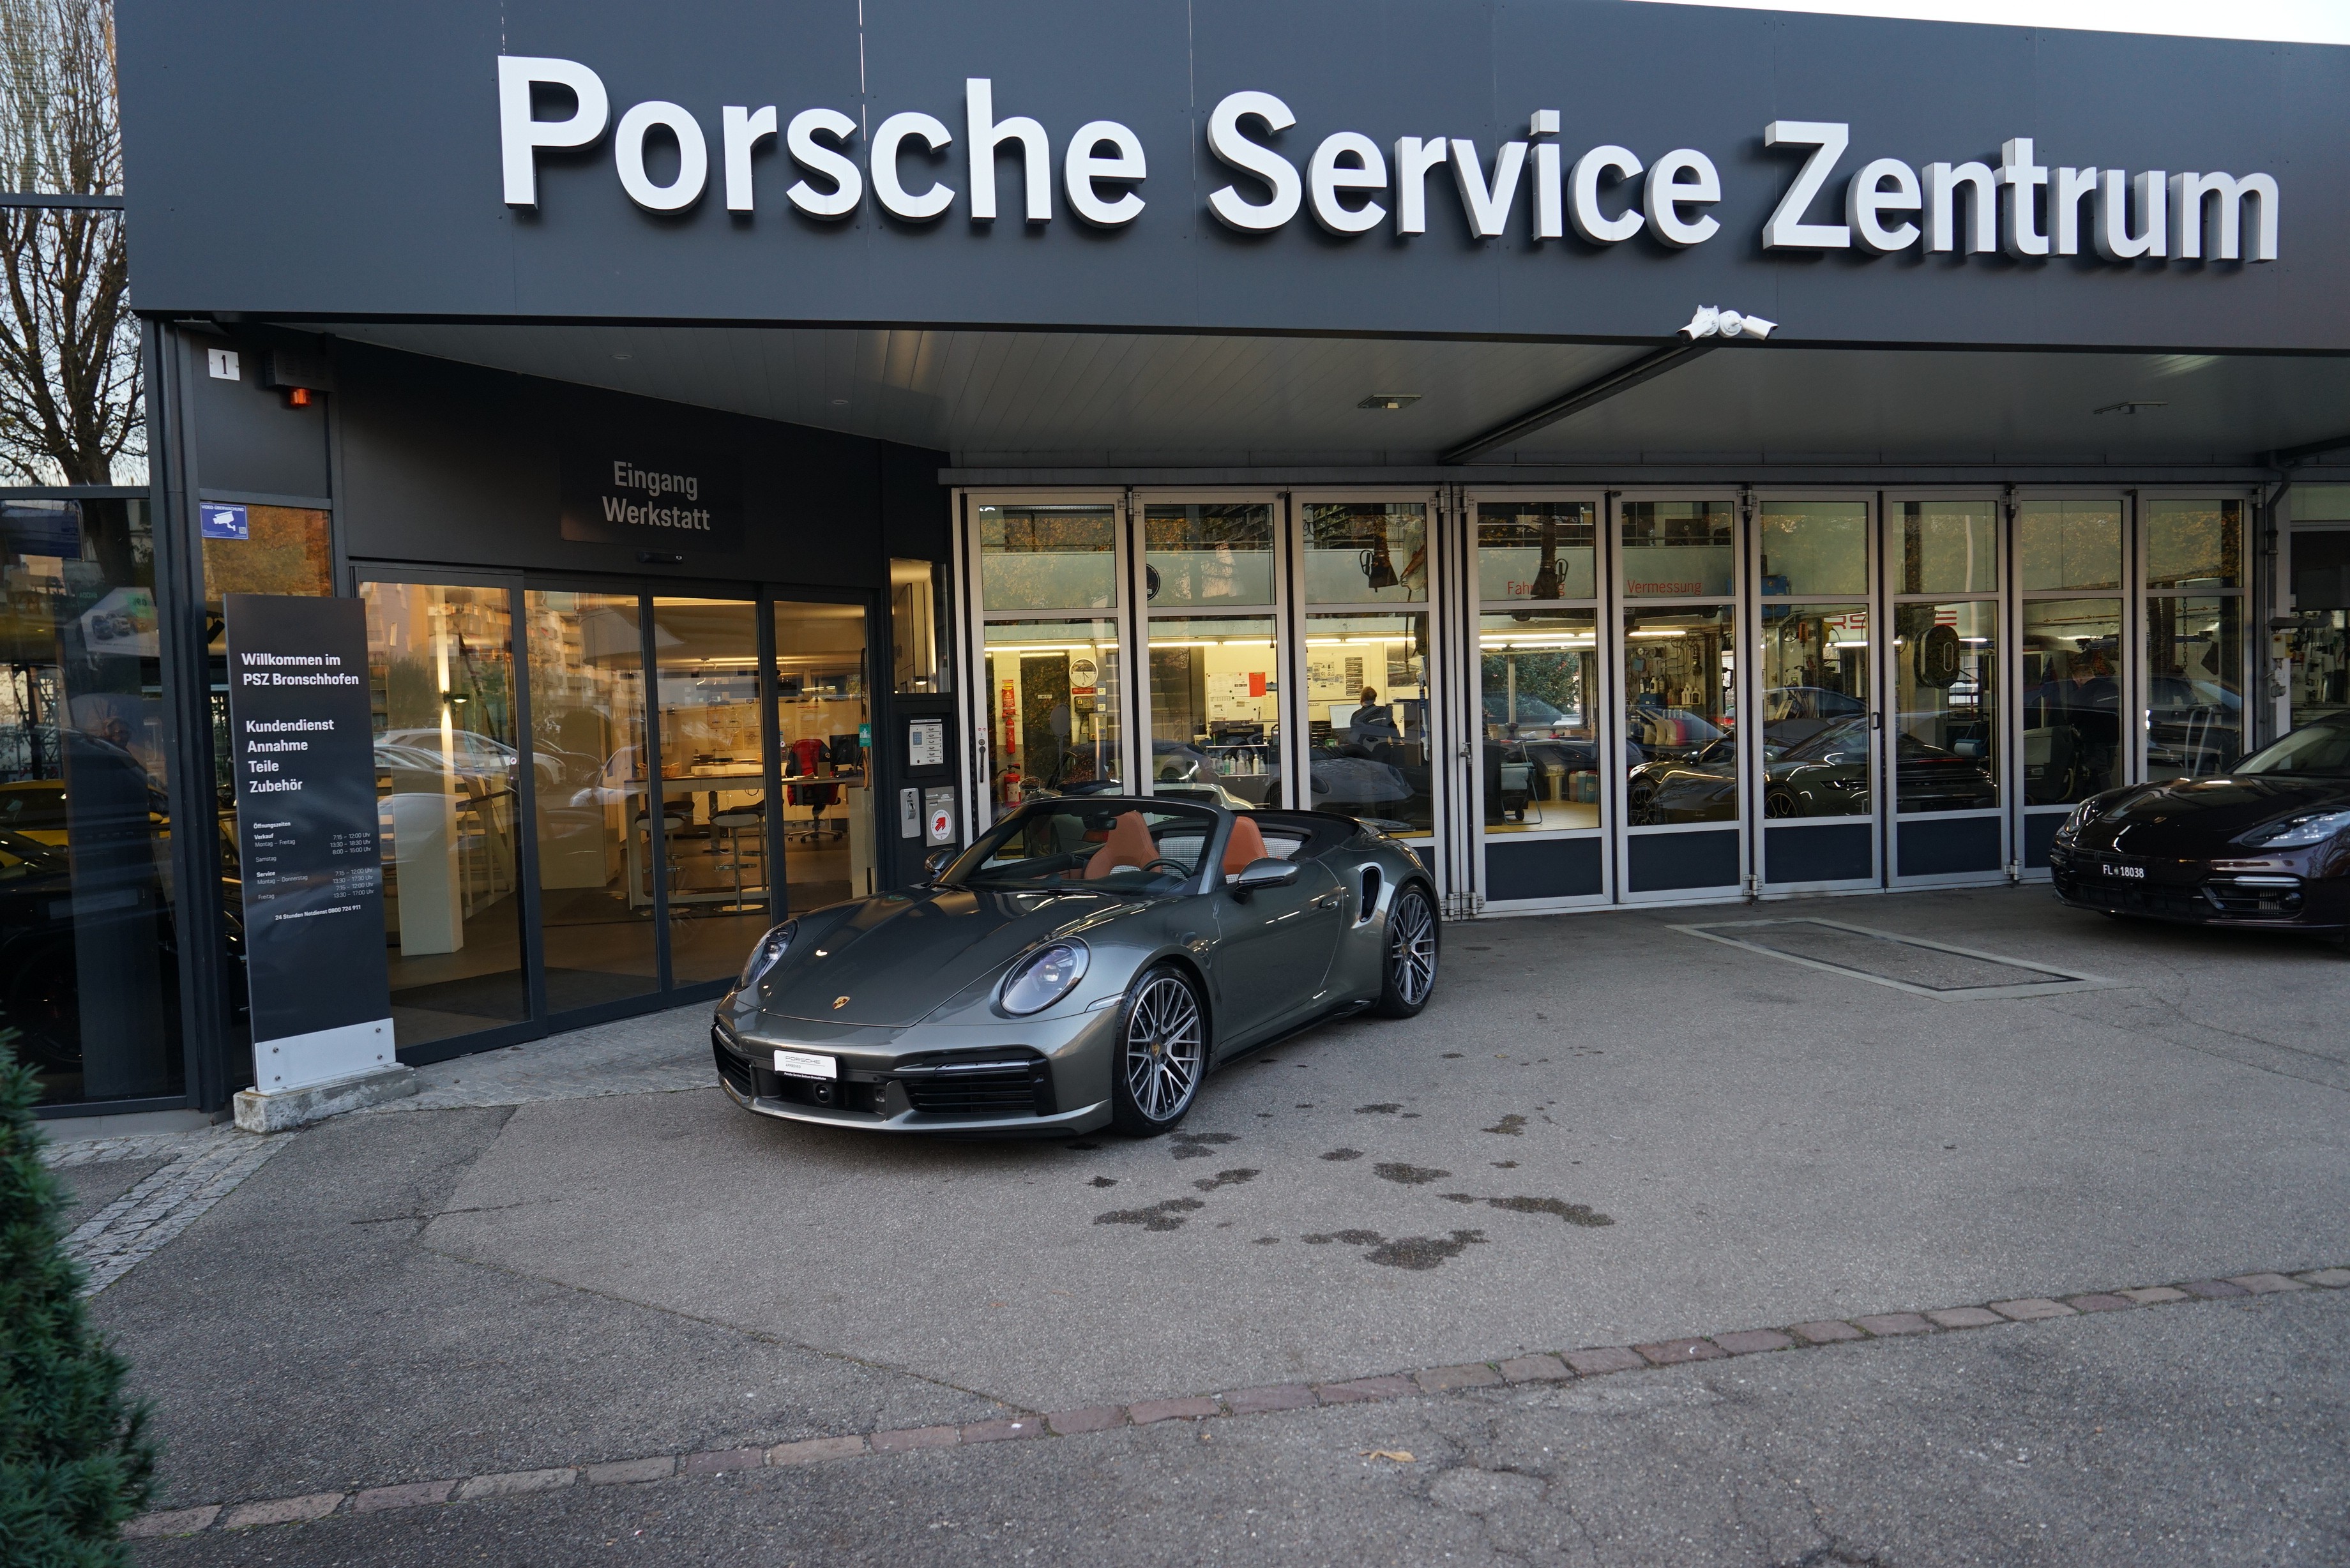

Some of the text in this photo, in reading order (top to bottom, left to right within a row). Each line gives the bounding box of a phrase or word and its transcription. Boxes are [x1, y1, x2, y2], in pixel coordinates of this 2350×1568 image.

[498, 56, 2278, 264] Porsche Service Zentrum
[221, 354, 228, 375] 1
[614, 461, 697, 501] Eingang
[602, 496, 710, 531] Werkstatt
[1628, 580, 1702, 595] Vermessung
[241, 653, 341, 665] Willkommen im
[243, 673, 359, 686] PSZ Bronschhofen
[246, 719, 335, 732] Kundendienst
[247, 739, 308, 753] Annahme
[248, 760, 279, 773] Teile
[249, 778, 303, 793] Zubehör
[2103, 864, 2144, 878] FL 18038
[785, 1055, 821, 1064] PORSCHE
